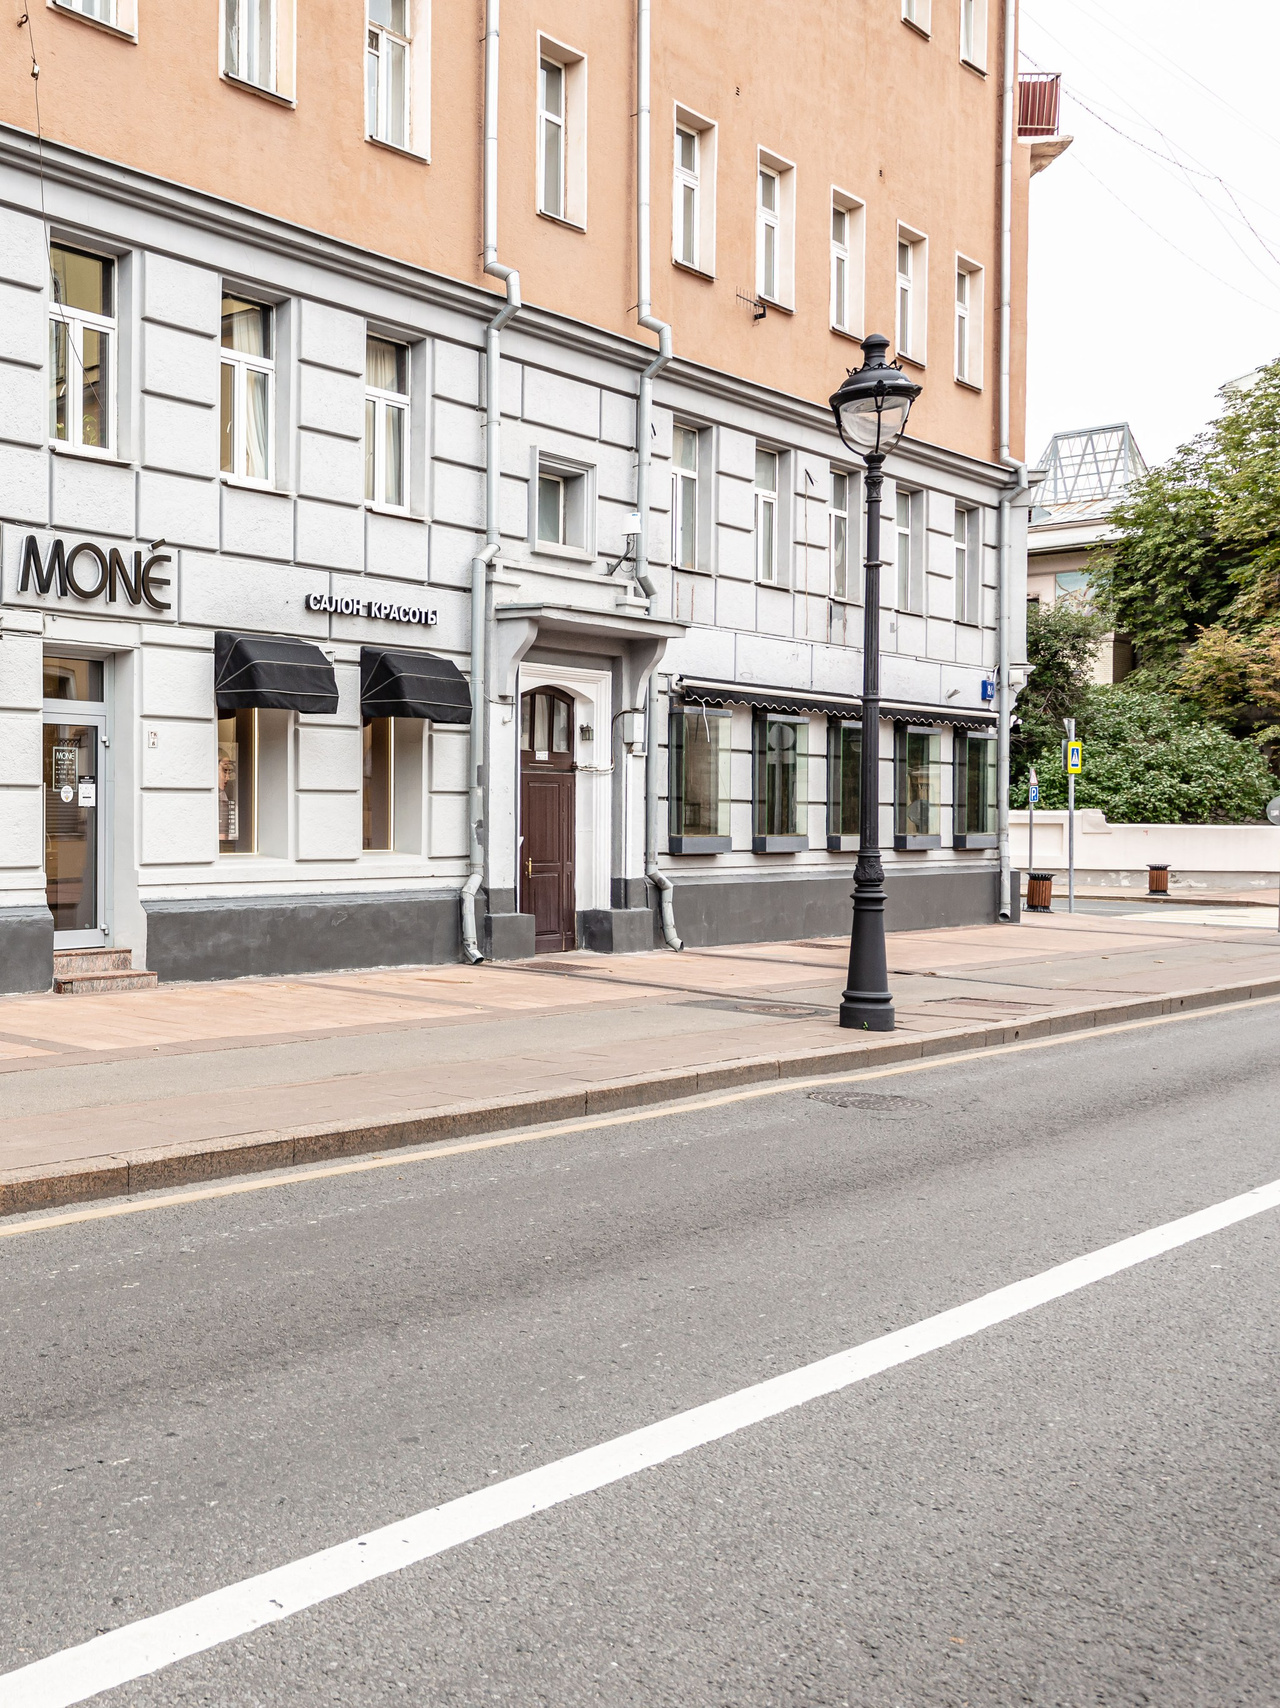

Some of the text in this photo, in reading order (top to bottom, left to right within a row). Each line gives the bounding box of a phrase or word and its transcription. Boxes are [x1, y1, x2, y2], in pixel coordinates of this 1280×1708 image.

[18, 535, 172, 611] MONÉ
[306, 593, 439, 625] САЛОН КРАСОТЫ
